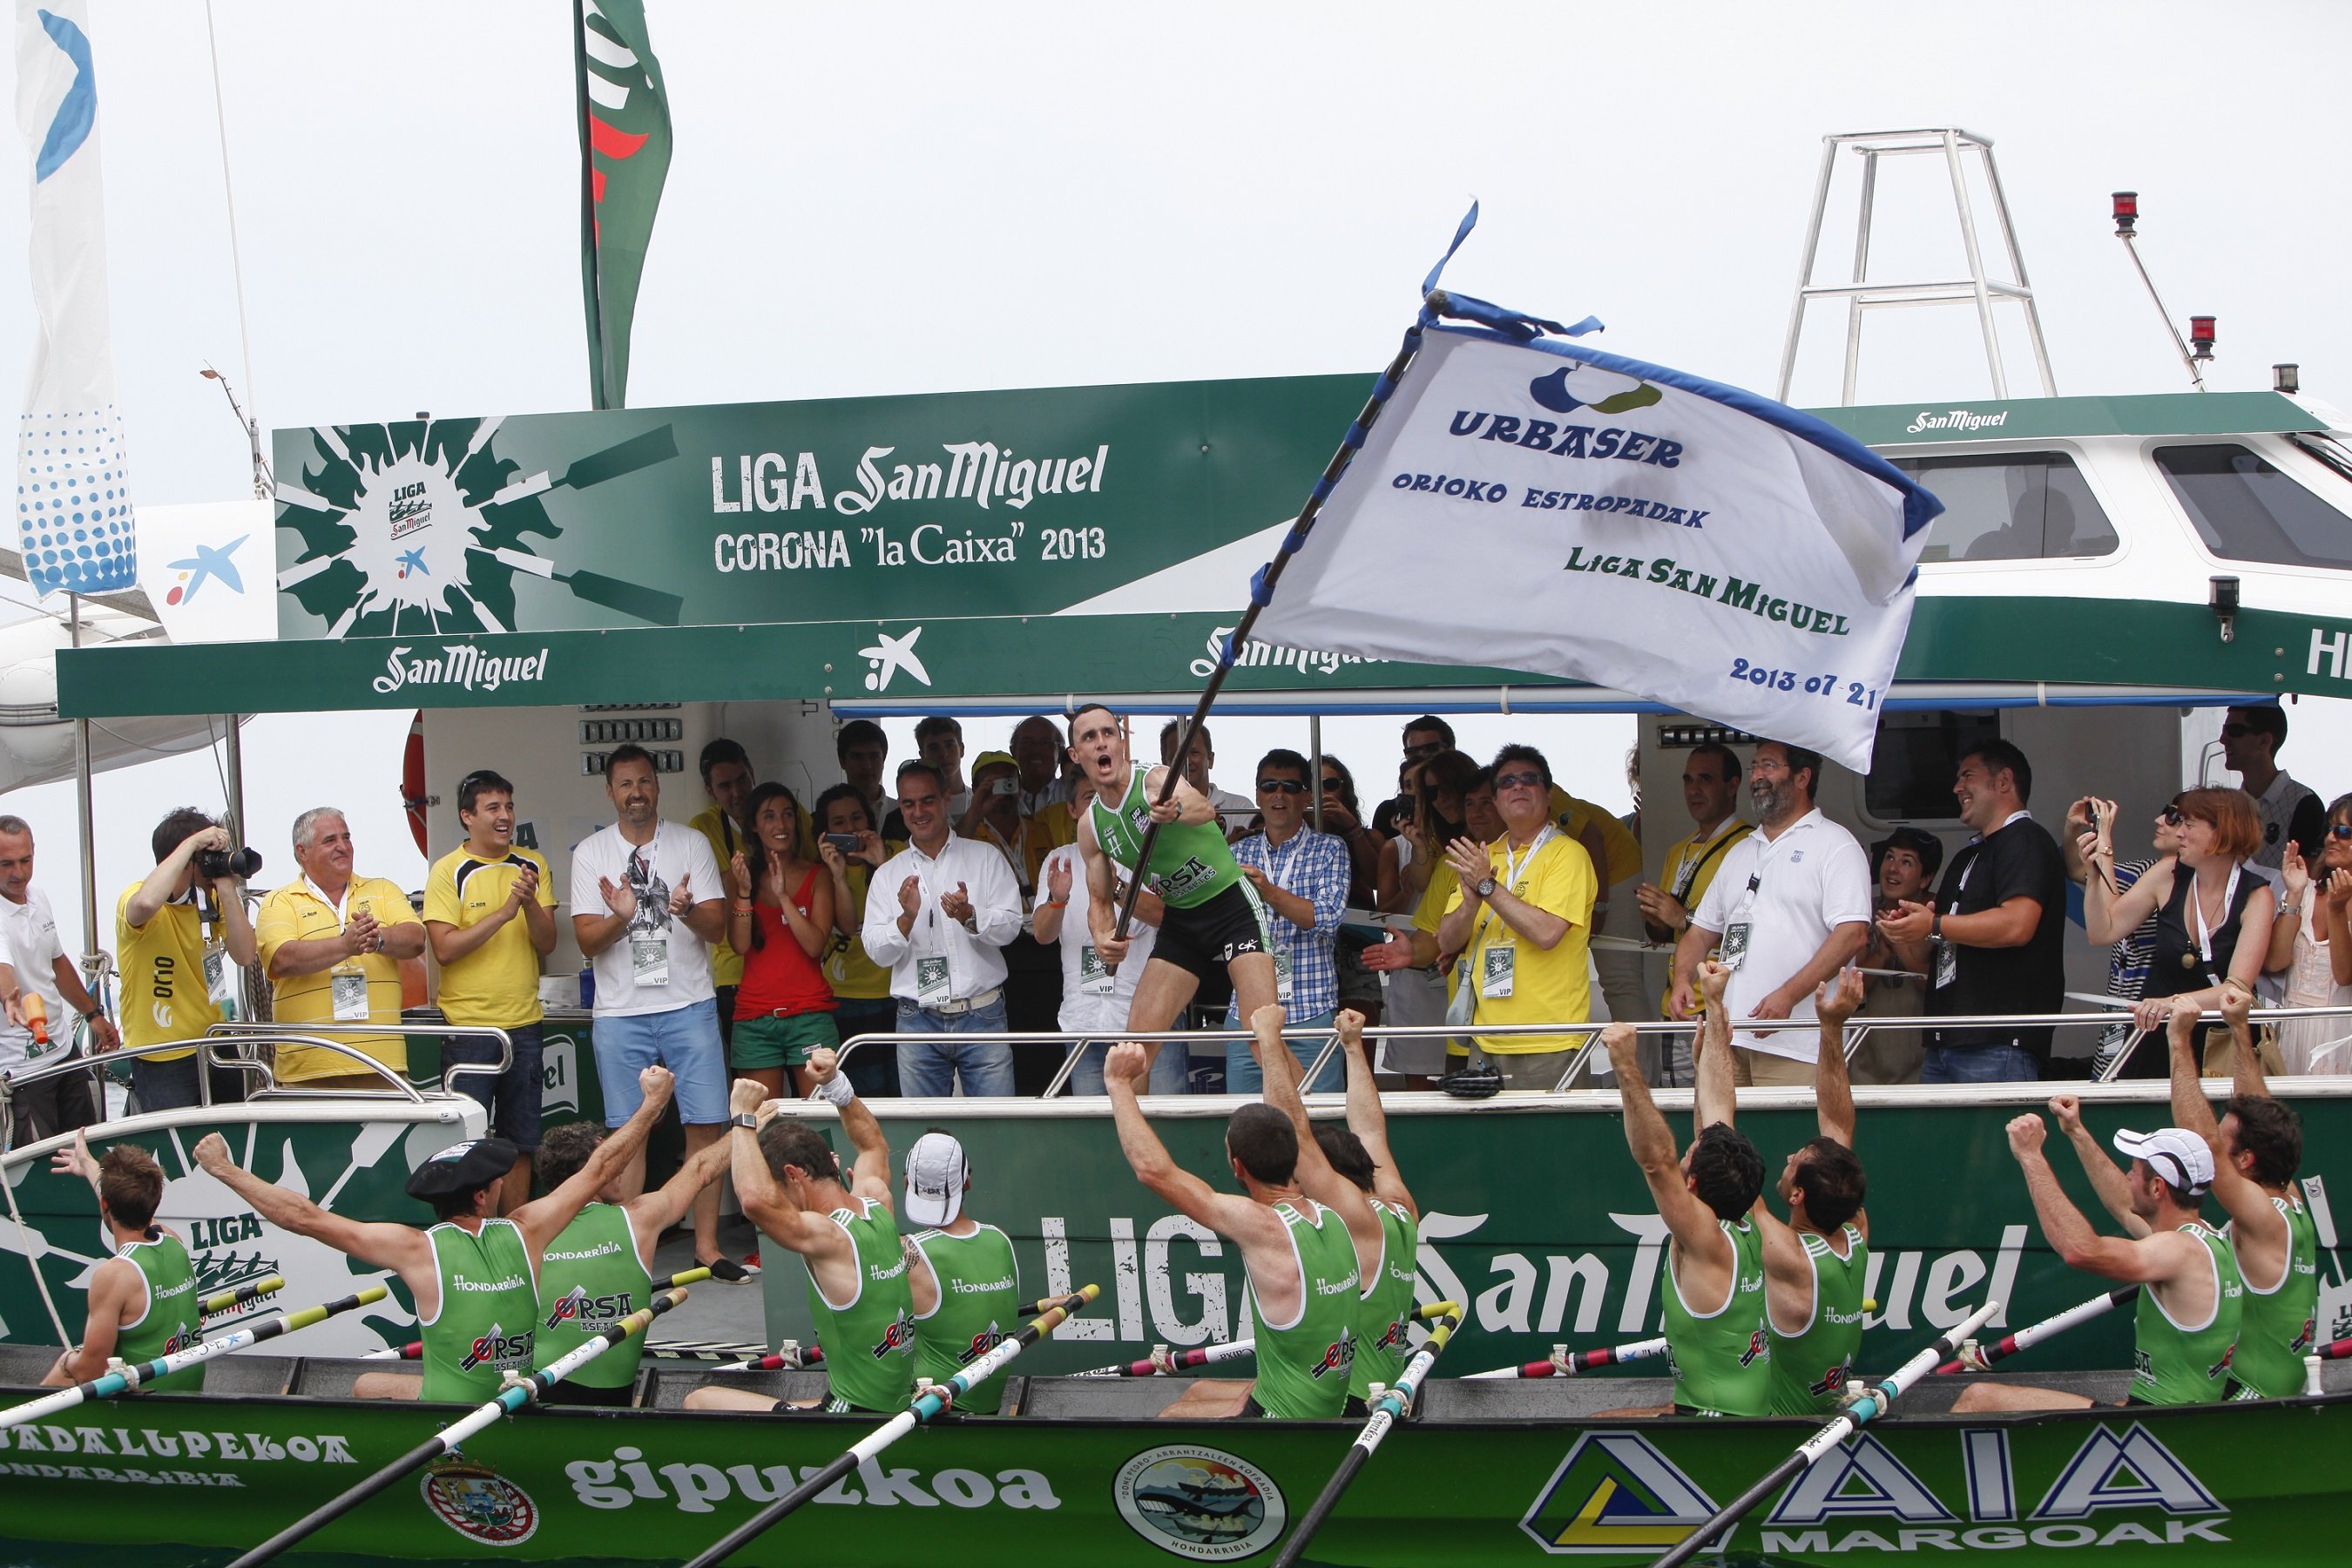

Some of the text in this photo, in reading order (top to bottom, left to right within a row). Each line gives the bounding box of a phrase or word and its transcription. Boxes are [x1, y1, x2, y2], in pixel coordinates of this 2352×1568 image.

[1450, 411, 1683, 469] URBASER
[394, 481, 427, 503] LIGA
[712, 452, 827, 513] LIGA
[1392, 473, 1710, 529] ORIOKO ESTROPADAK
[714, 531, 851, 572] CORONA
[1041, 527, 1106, 560] 2013
[1564, 546, 1645, 579] LIGA
[1716, 576, 1850, 636] MIGUEL
[152, 956, 175, 998] orio
[218, 989, 227, 998] VIP
[936, 995, 950, 1004] VIP
[191, 1212, 263, 1251] LIGA
[453, 1274, 525, 1292] HONDARRIBIA
[951, 1274, 1015, 1294] HONDARRIBIA
[564, 1446, 1062, 1512] gipuzkoa
[1156, 1449, 1237, 1466] ARRANTZALEEN
[1238, 1464, 1274, 1501] KOFRADIA
[1761, 1421, 2230, 1526] AIA
[1172, 1540, 1253, 1555] HONDARRIBIA
[1760, 1518, 2232, 1553] MARGOAK
